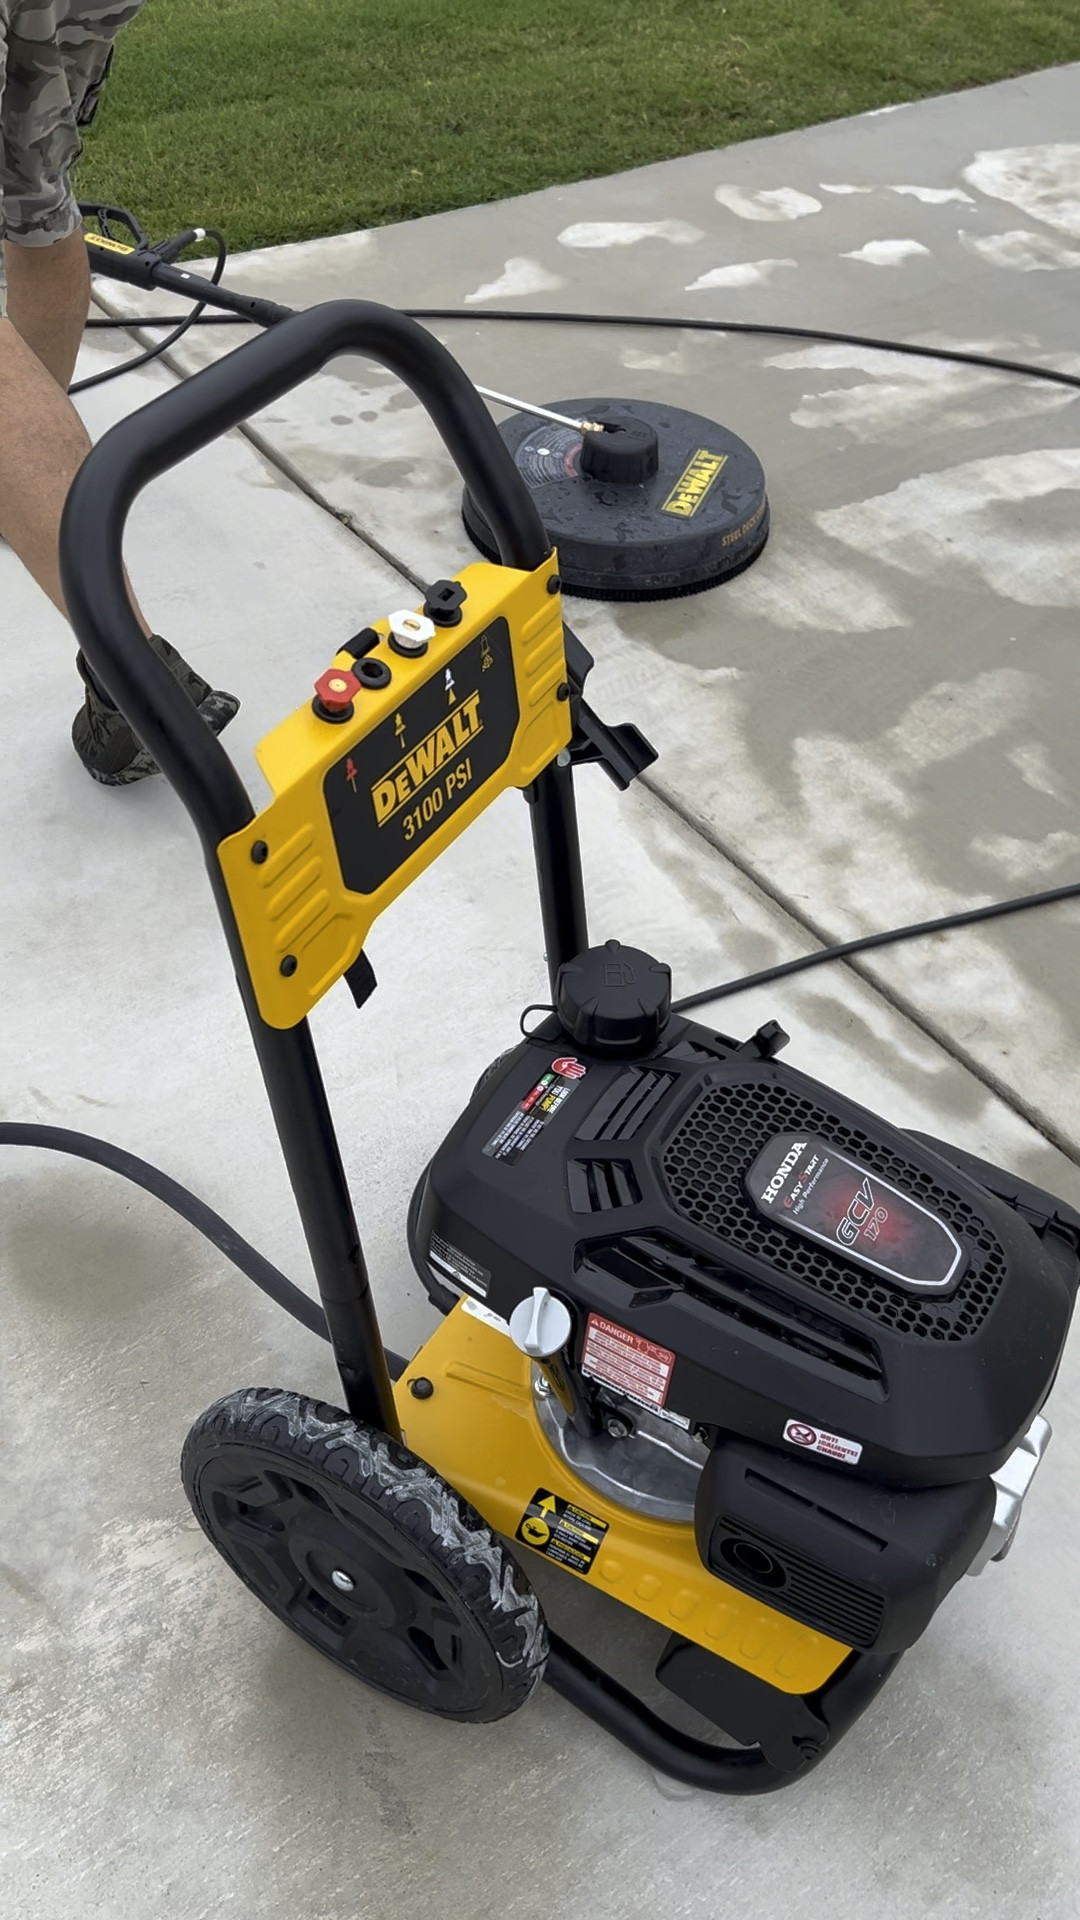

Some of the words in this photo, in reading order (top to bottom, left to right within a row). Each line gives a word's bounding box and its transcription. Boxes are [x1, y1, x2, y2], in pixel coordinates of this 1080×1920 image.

[664, 449, 724, 516] DEWALT
[371, 691, 482, 825] DEWALT
[402, 786, 444, 841] 3100
[445, 757, 473, 800] PSI
[761, 1142, 808, 1204] HONDA
[783, 1180, 804, 1208] EASY
[798, 1154, 820, 1183] START
[792, 1198, 805, 1215] High
[802, 1157, 829, 1199] Performance
[836, 1176, 875, 1246] GCV
[863, 1206, 888, 1242] 170
[599, 1320, 635, 1344] DANGER
[820, 1433, 839, 1444] HOT!
